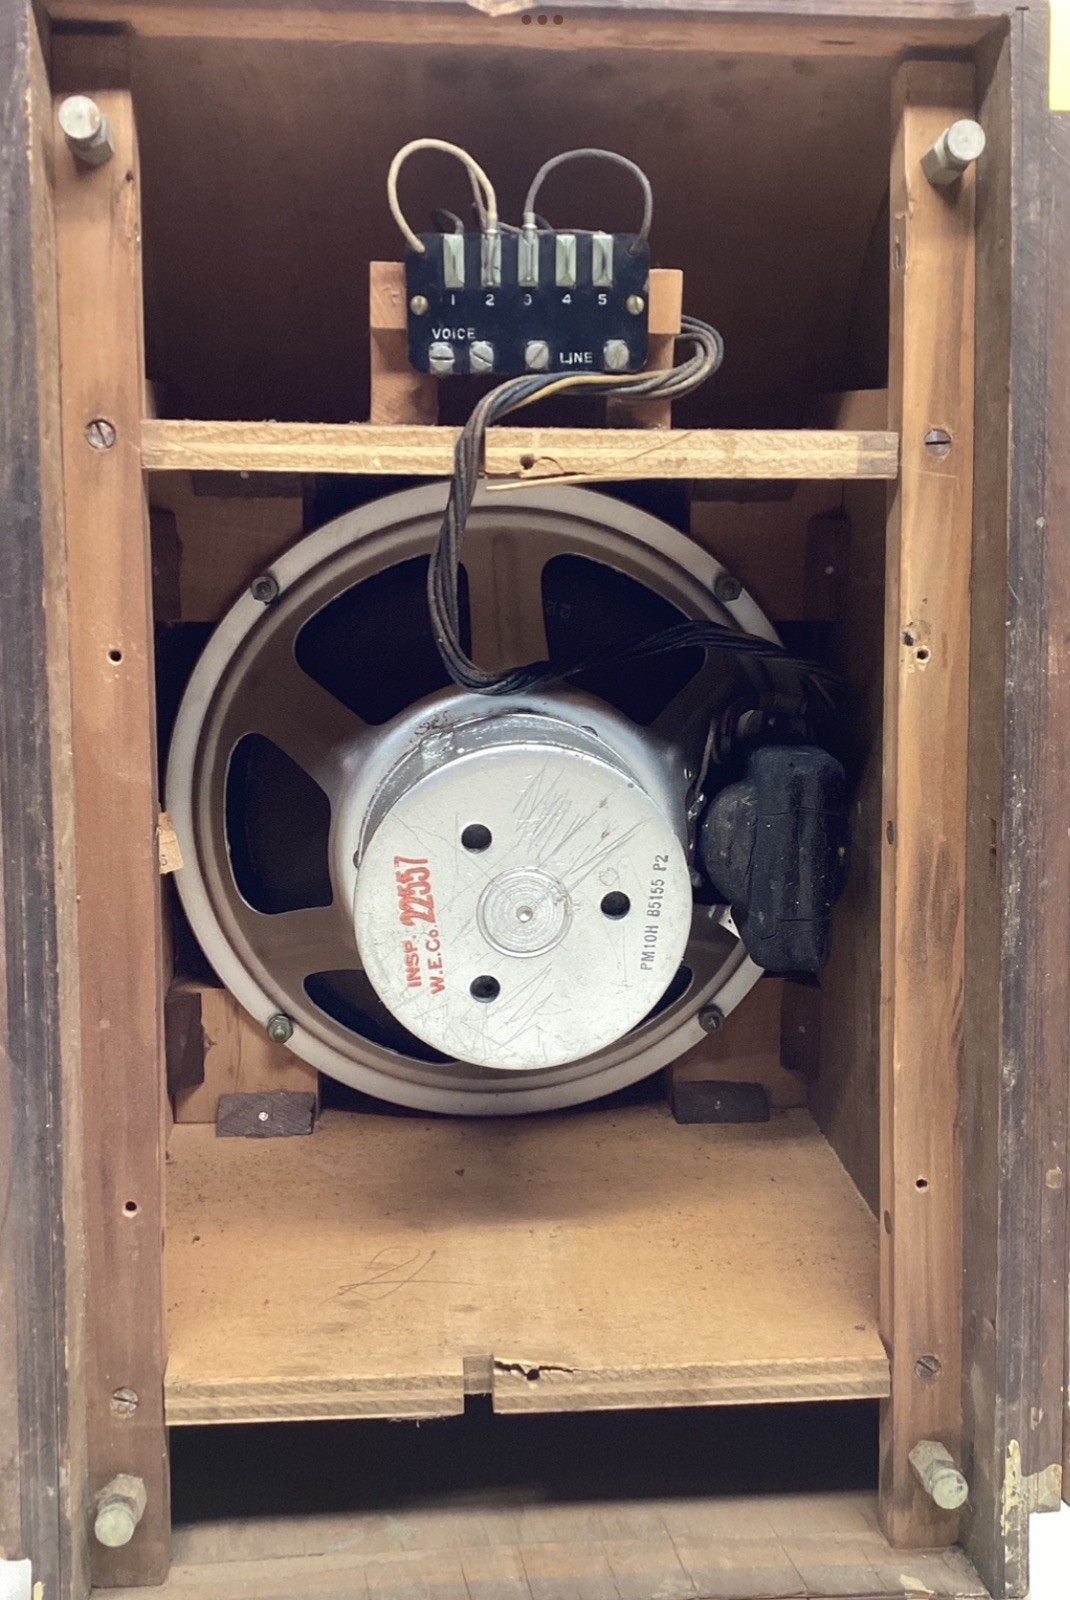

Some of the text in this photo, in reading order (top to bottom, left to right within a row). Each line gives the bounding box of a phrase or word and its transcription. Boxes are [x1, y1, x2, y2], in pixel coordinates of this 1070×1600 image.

[485, 294, 495, 306] 2
[561, 294, 572, 306] 4
[597, 294, 608, 306] 5
[431, 327, 476, 340] VOICE
[559, 351, 593, 364] LINE
[640, 854, 669, 971] PM10H B5155 P2
[393, 855, 436, 988] INSP. 22557
